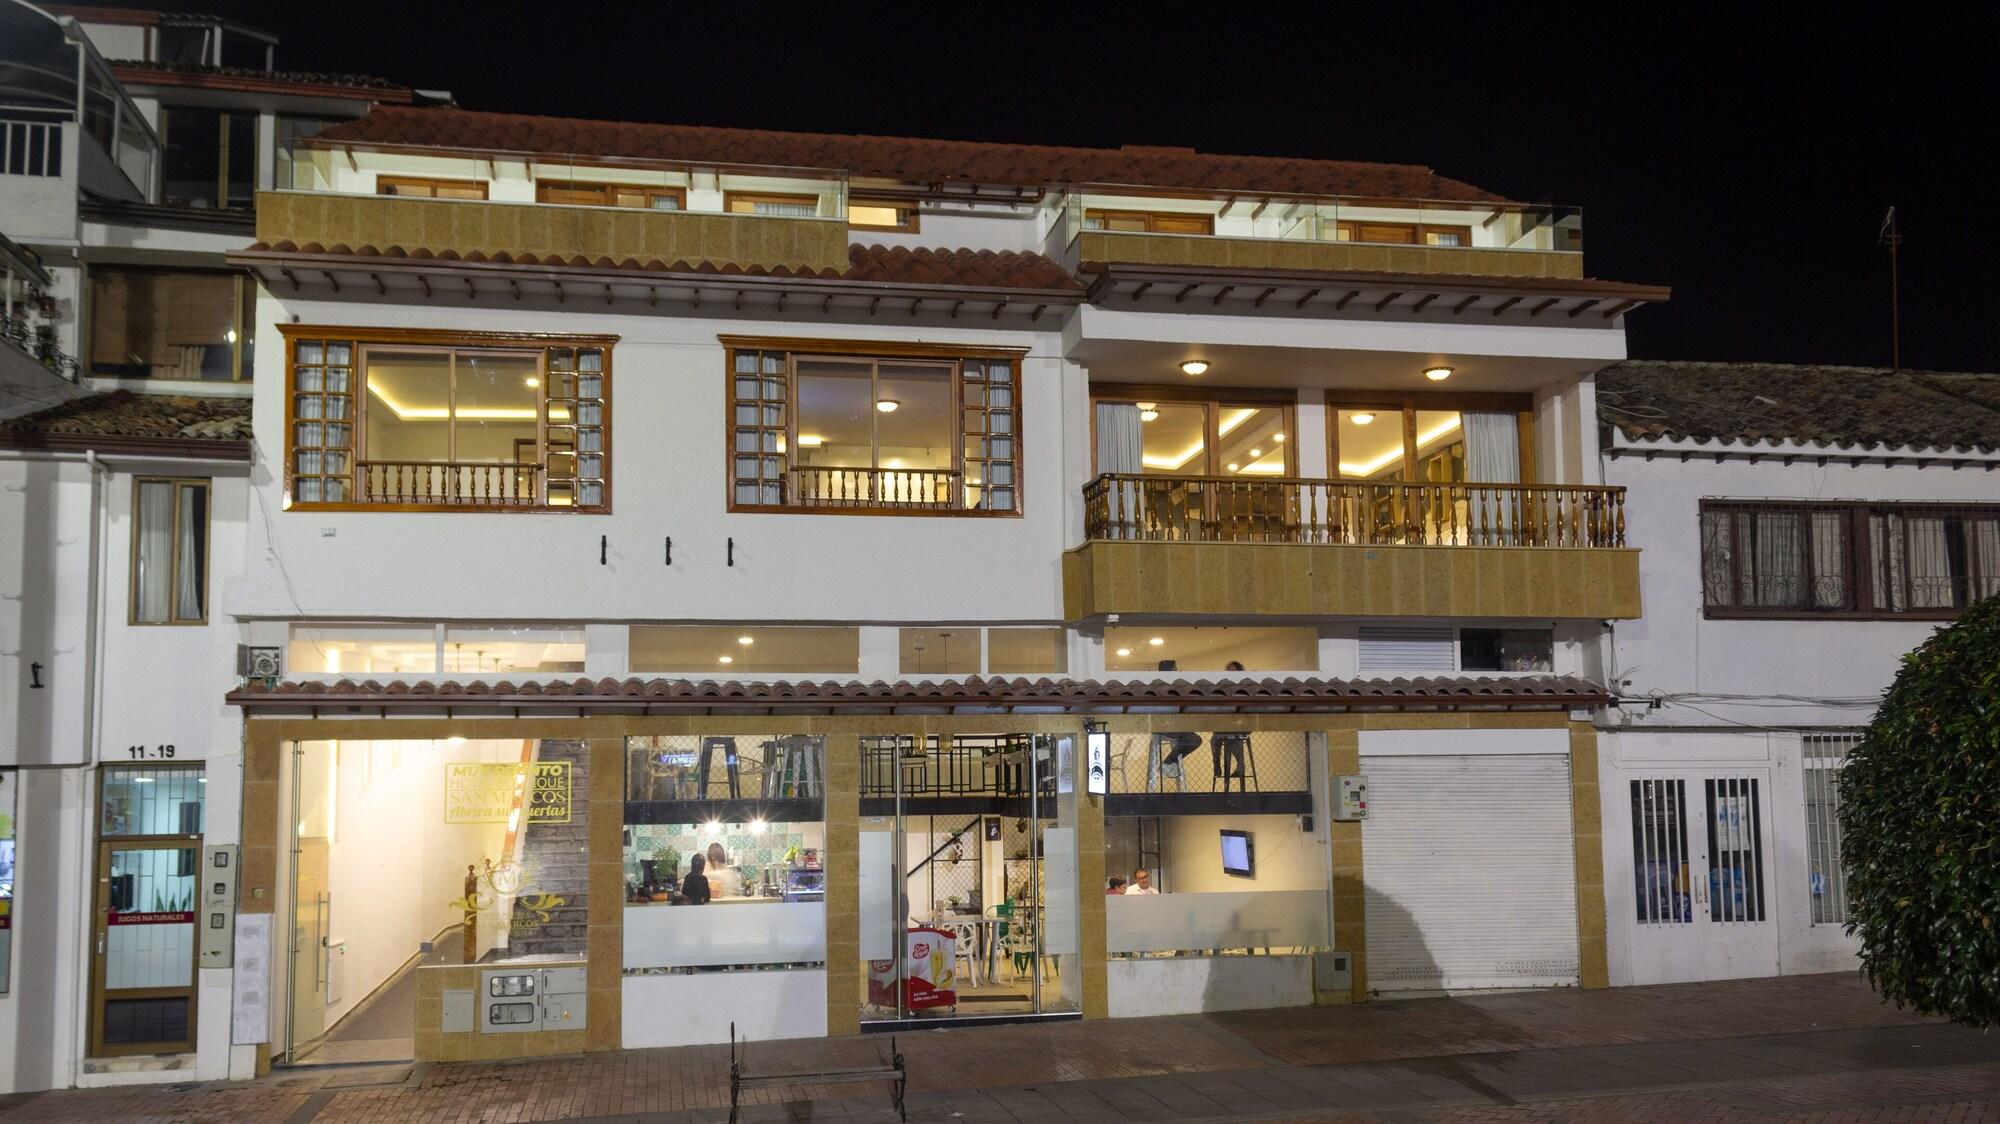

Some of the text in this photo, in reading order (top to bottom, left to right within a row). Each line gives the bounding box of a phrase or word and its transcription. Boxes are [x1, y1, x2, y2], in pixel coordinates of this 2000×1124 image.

[497, 777, 565, 789] BOIQUE
[450, 791, 566, 803] SAN MACOS
[142, 913, 185, 922] NATURALES
